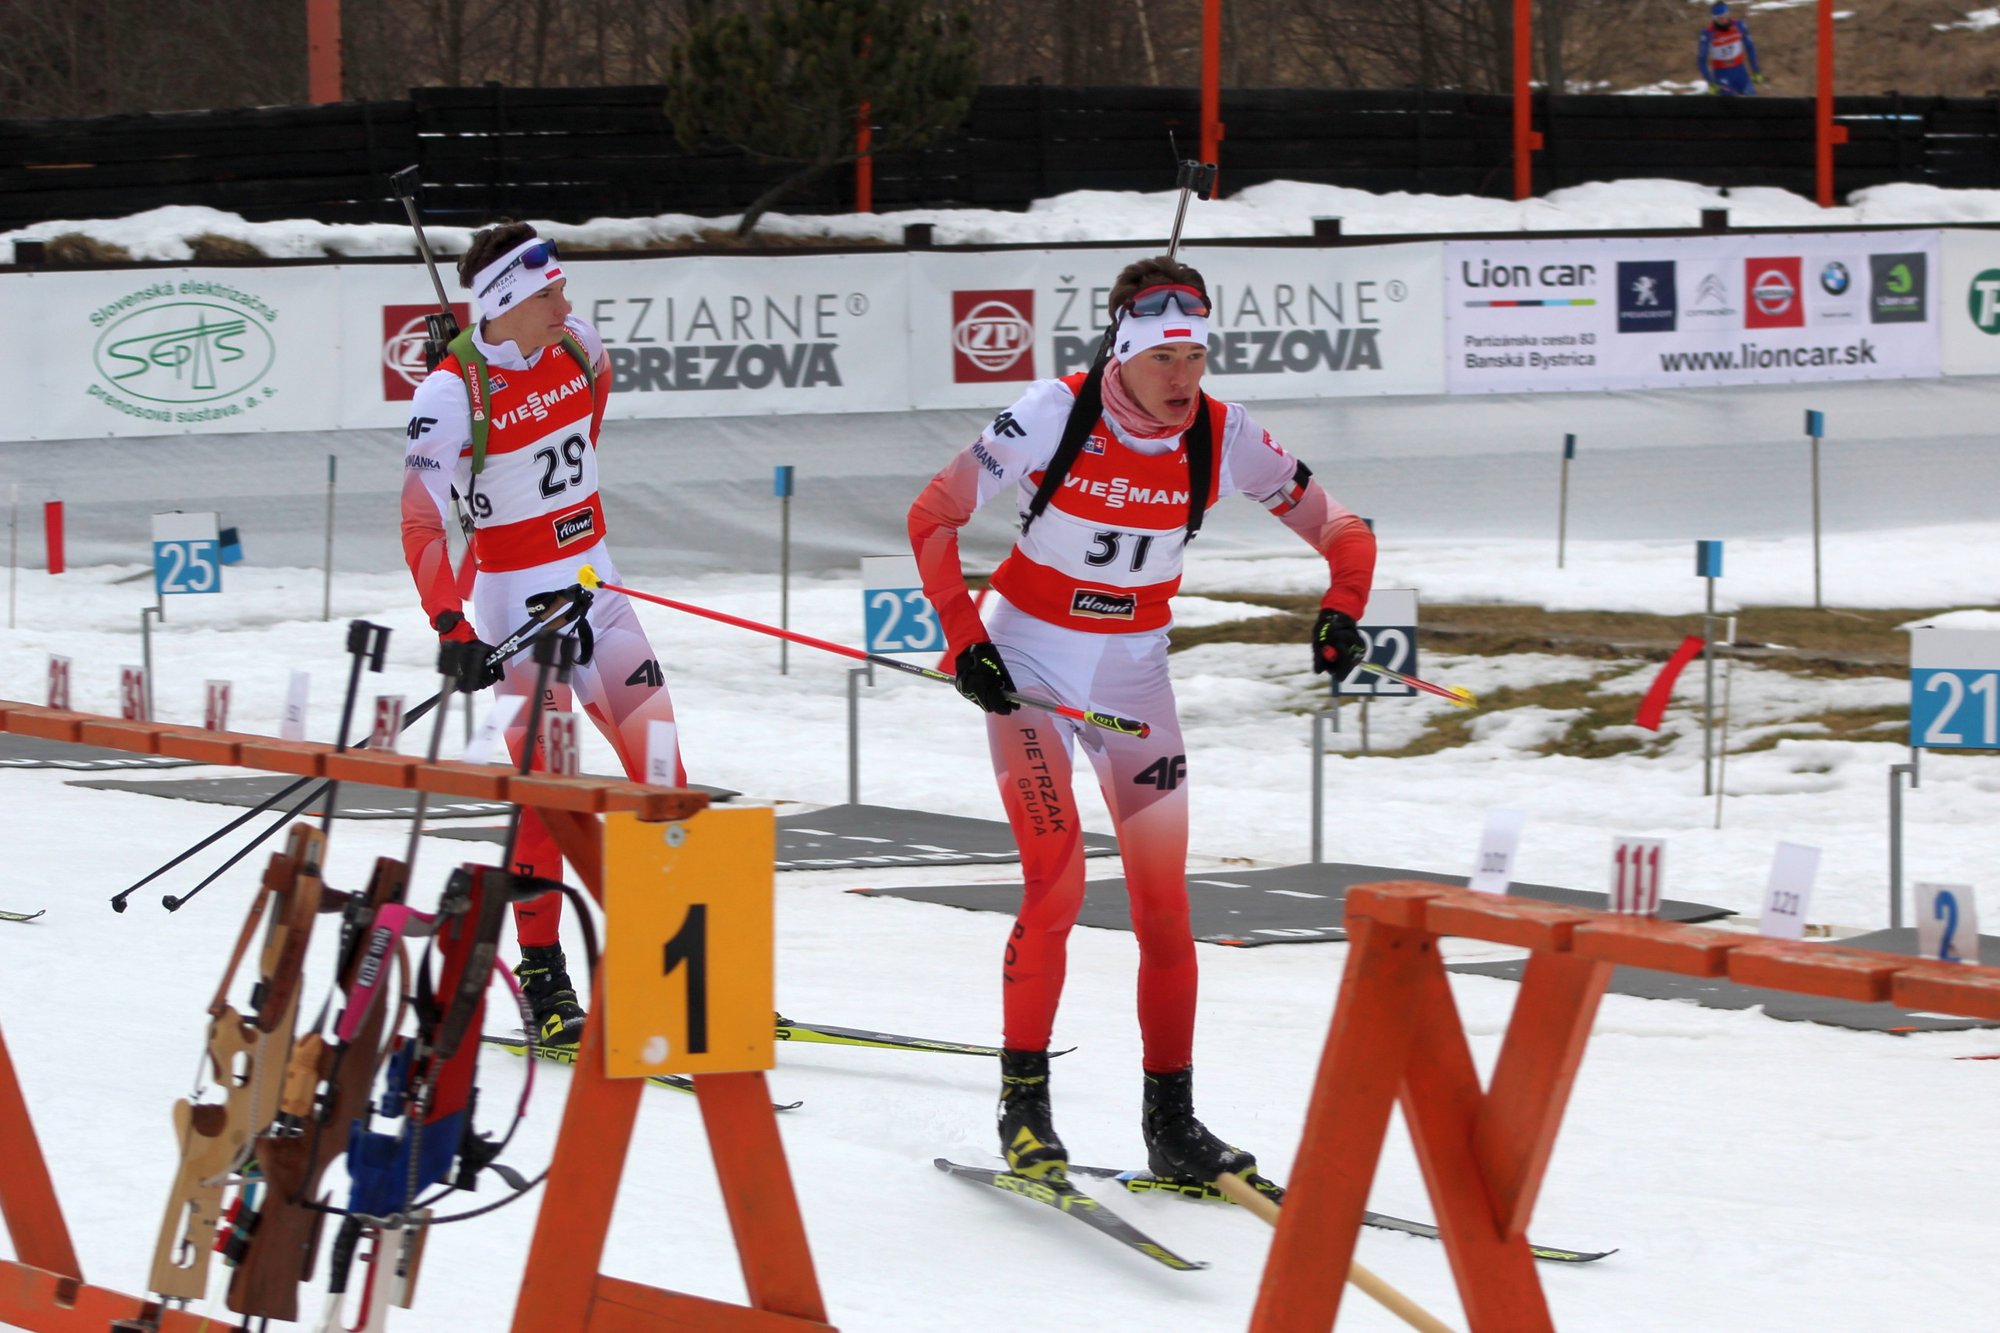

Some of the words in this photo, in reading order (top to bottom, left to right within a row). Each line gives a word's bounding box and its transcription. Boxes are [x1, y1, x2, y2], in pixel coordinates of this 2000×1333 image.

[1052, 275, 1379, 331] ŽEIARNE
[1462, 259, 1531, 287] Lion
[1539, 264, 1596, 286] car
[593, 293, 837, 343] EZIARNE
[1661, 339, 1876, 372] www.lioncar.sk
[533, 432, 587, 500] 29
[1063, 472, 1190, 509] VIESSMAN
[160, 542, 214, 592] 25
[870, 590, 937, 650] 23
[1338, 628, 1409, 694] 22
[1924, 671, 1998, 744] 21
[1017, 777, 1048, 837] GRUPA
[1019, 727, 1067, 833] PIETRZAK
[1934, 889, 1962, 963] 2
[663, 903, 708, 1055] 1
